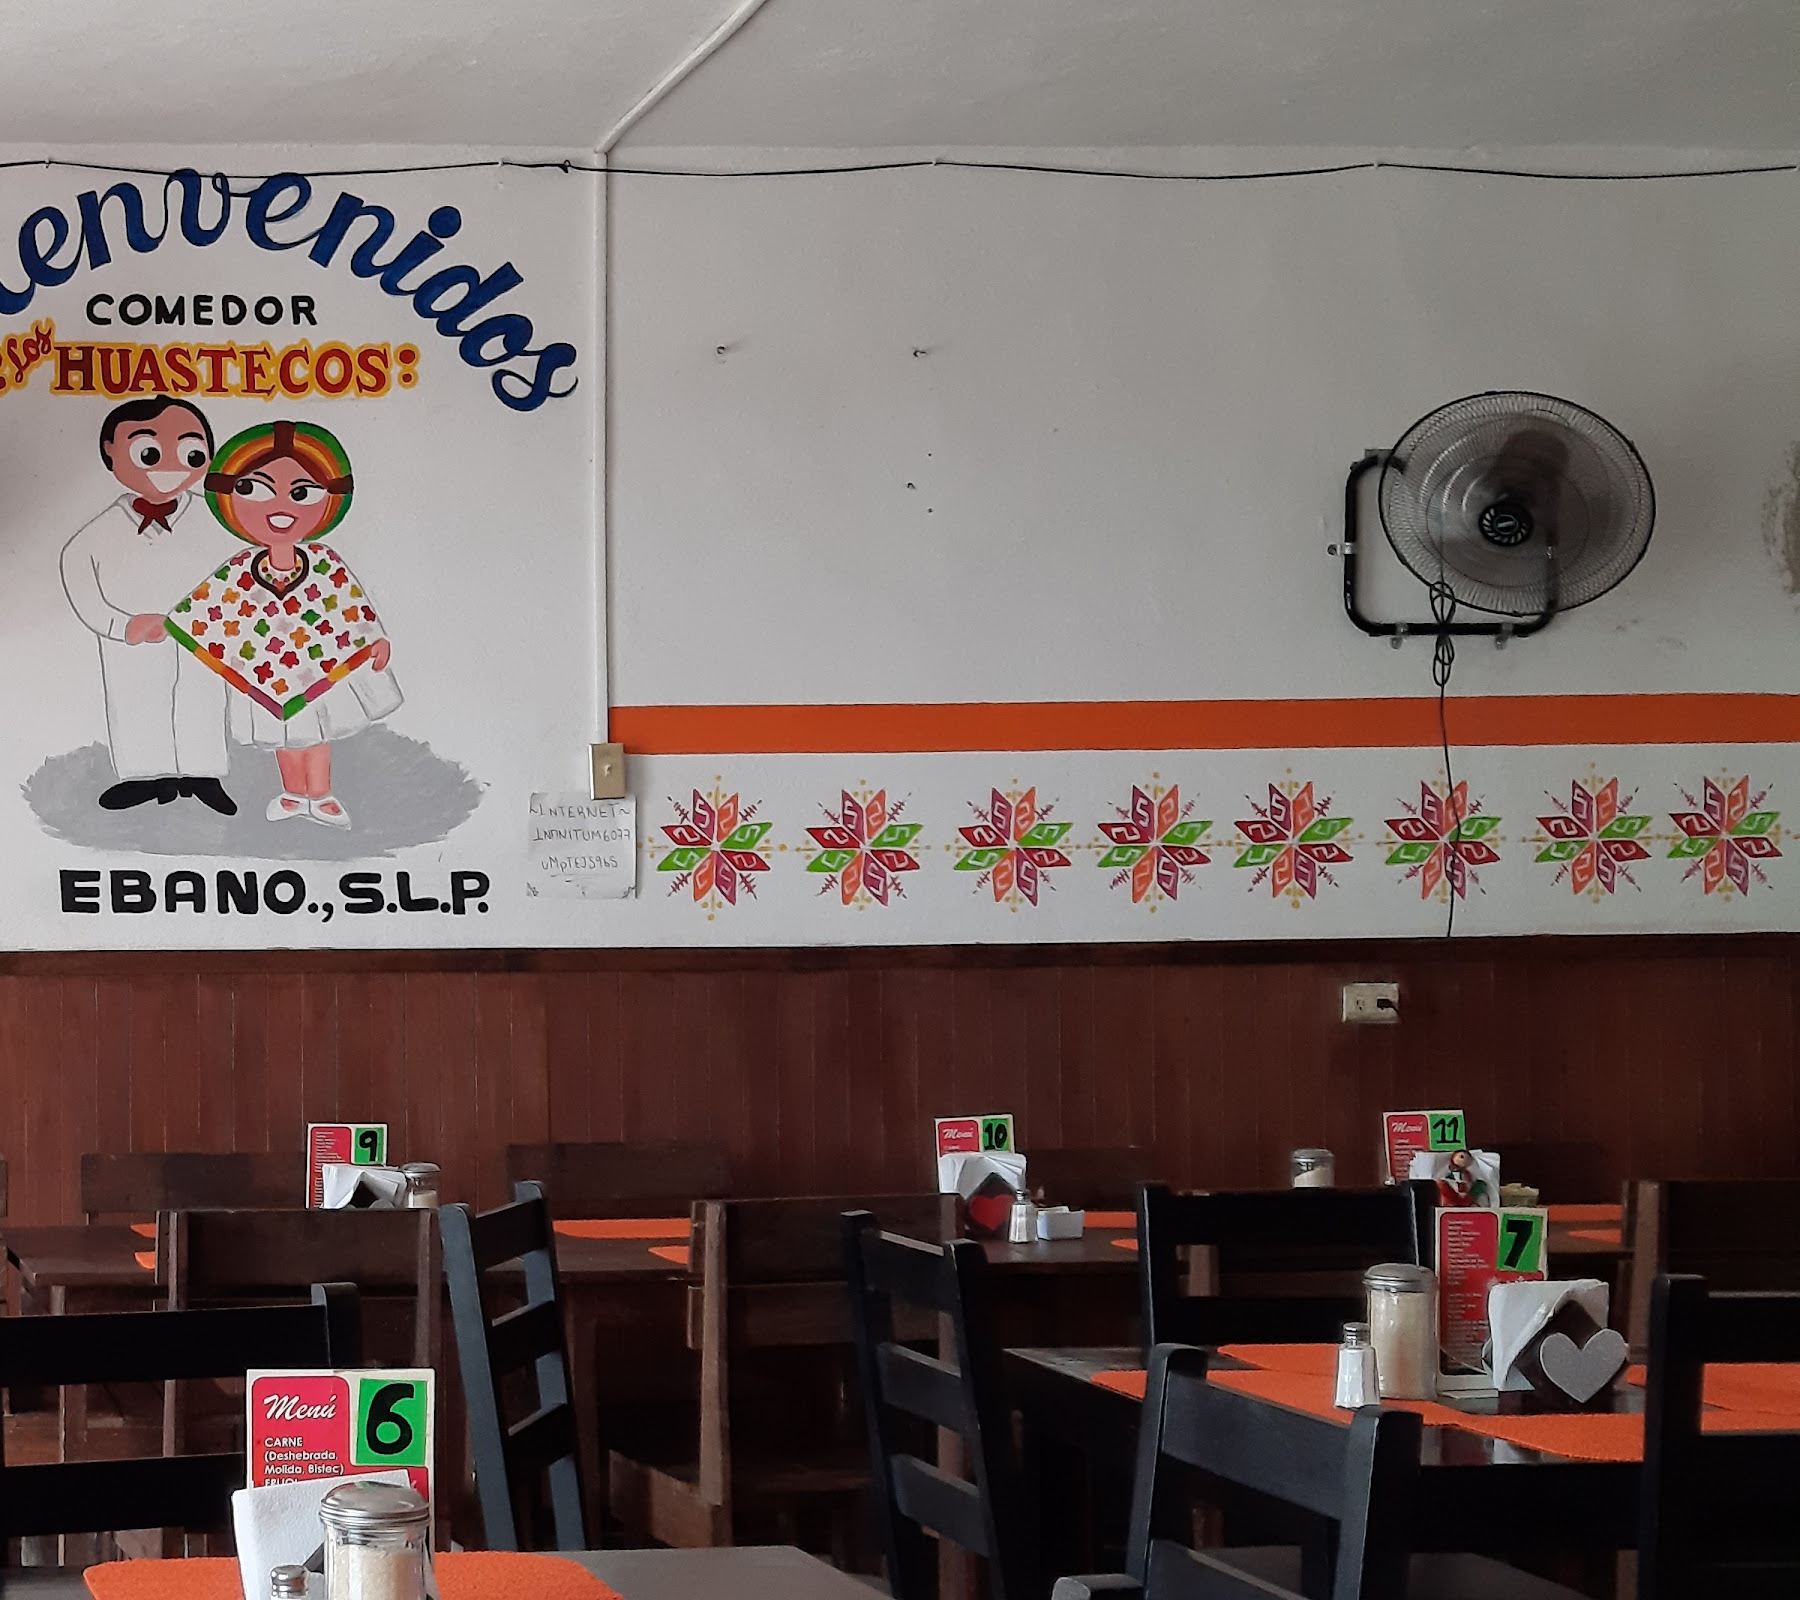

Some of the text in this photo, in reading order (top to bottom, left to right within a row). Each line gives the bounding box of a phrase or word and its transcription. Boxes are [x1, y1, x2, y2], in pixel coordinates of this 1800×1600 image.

[85, 293, 319, 327] COMEDOR
[54, 345, 391, 396] HUASTECOS
[984, 1122, 1008, 1150] 10
[1432, 1116, 1462, 1144] 11
[358, 1130, 378, 1162] 9
[1504, 1219, 1534, 1269] 7
[263, 1393, 338, 1421] Menú
[365, 1382, 415, 1456] 6
[263, 1436, 304, 1448] CARNE
[263, 1450, 339, 1463] (Deshebrada,
[263, 1463, 345, 1476] Molida, Bistec)
